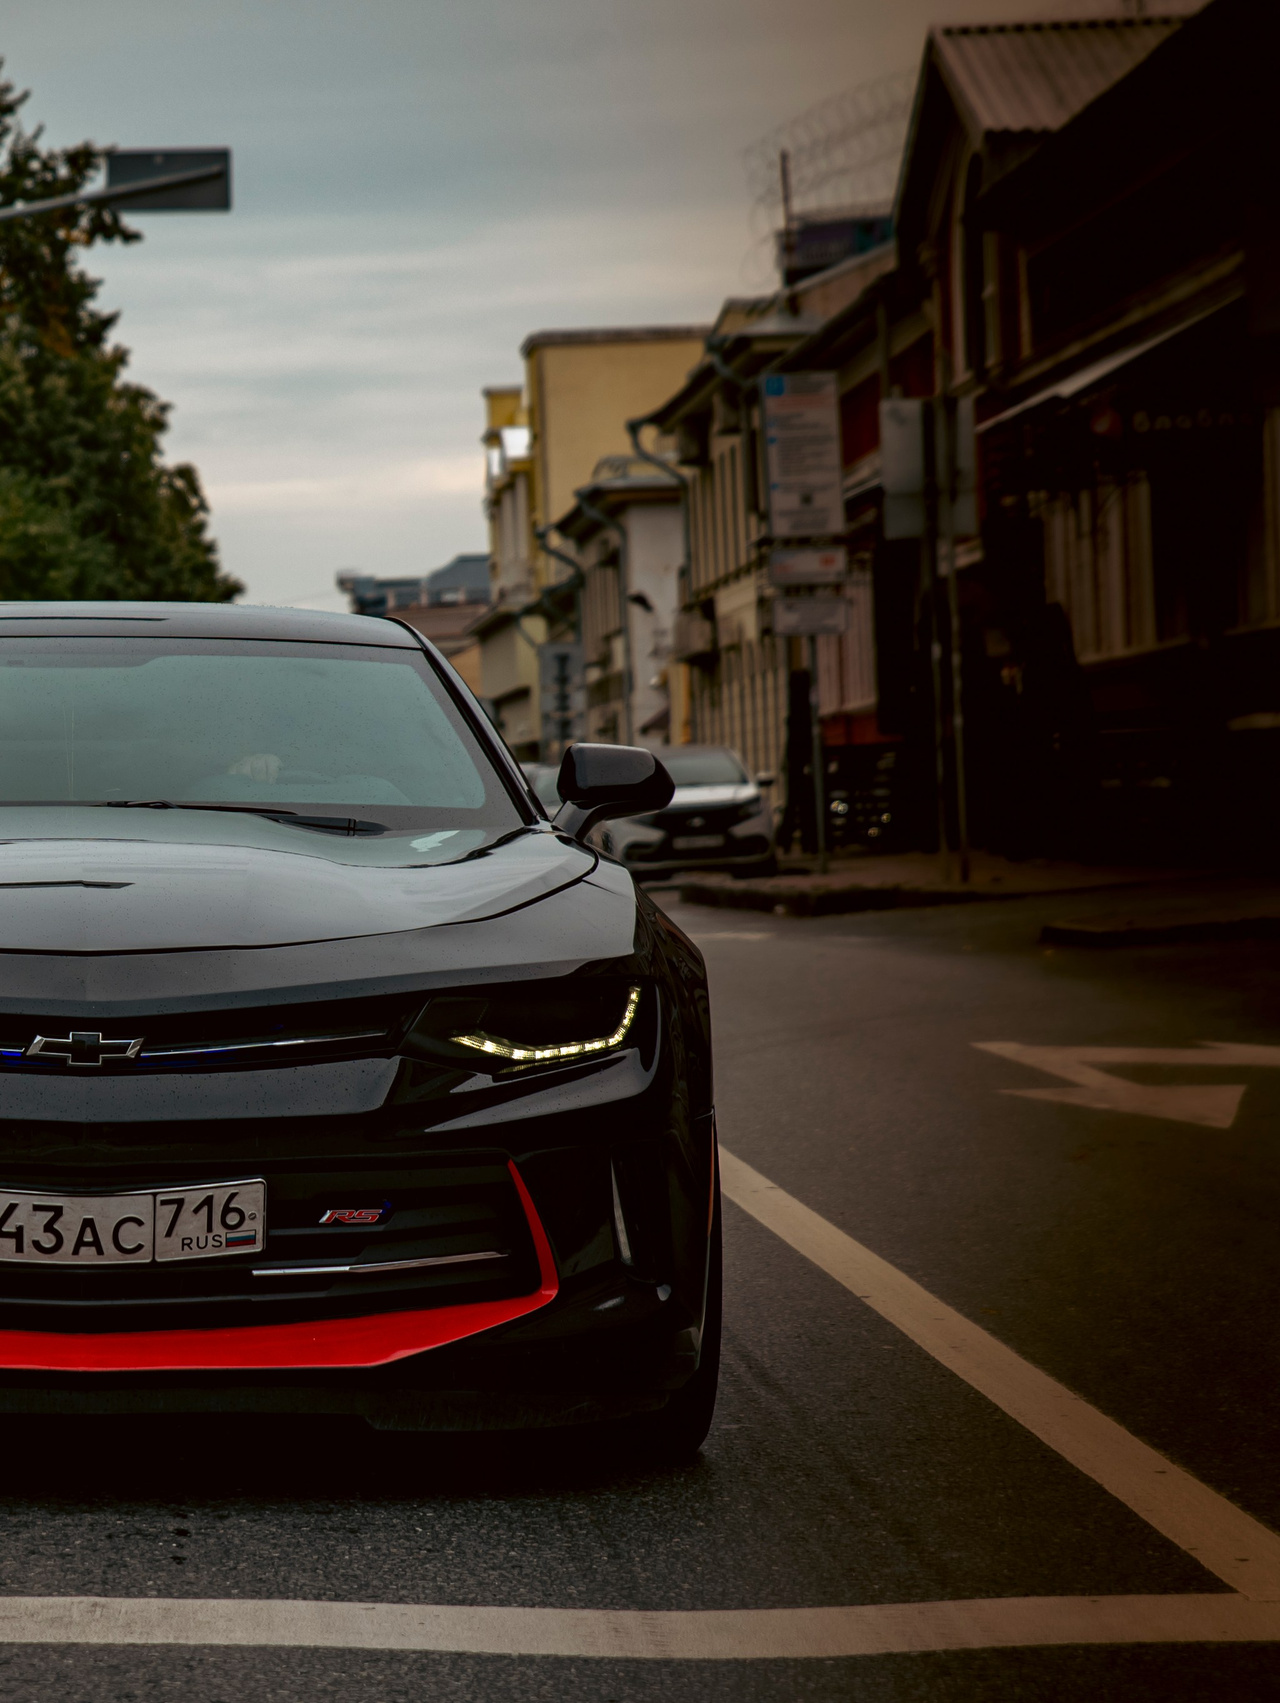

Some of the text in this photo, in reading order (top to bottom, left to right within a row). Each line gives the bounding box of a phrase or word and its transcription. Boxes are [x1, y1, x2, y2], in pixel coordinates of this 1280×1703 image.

[160, 1191, 246, 1238] 716
[323, 1209, 383, 1223] RS
[181, 1234, 223, 1251] RUS
